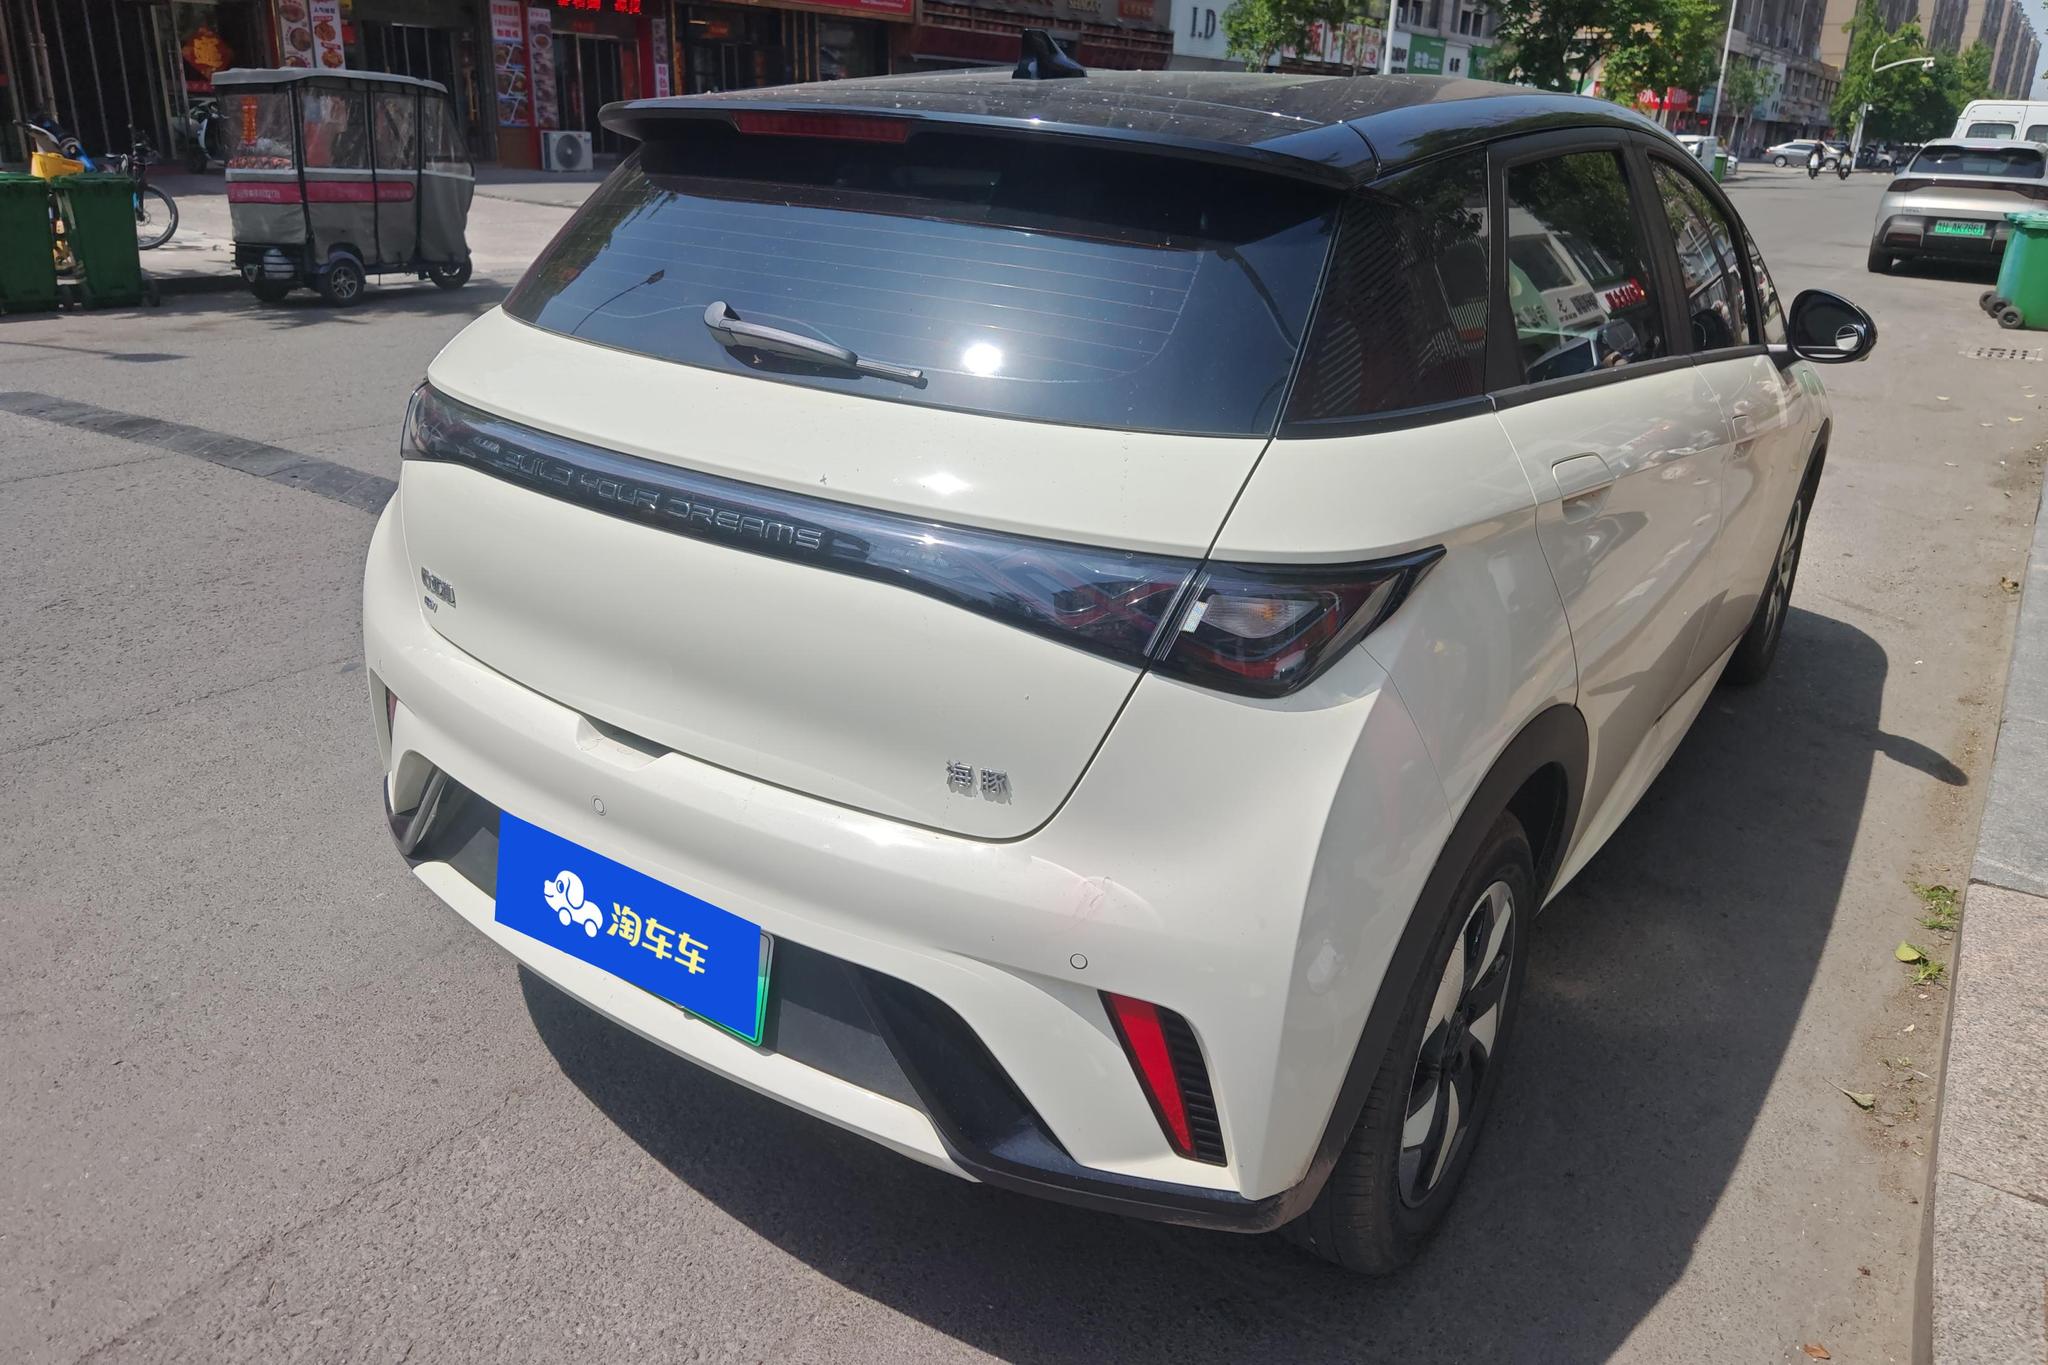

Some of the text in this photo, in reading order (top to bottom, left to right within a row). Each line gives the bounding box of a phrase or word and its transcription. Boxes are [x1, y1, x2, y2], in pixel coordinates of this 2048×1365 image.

[580, 472, 660, 510] YOUR
[667, 497, 824, 550] DREAMS
[946, 759, 1012, 805] 海豚
